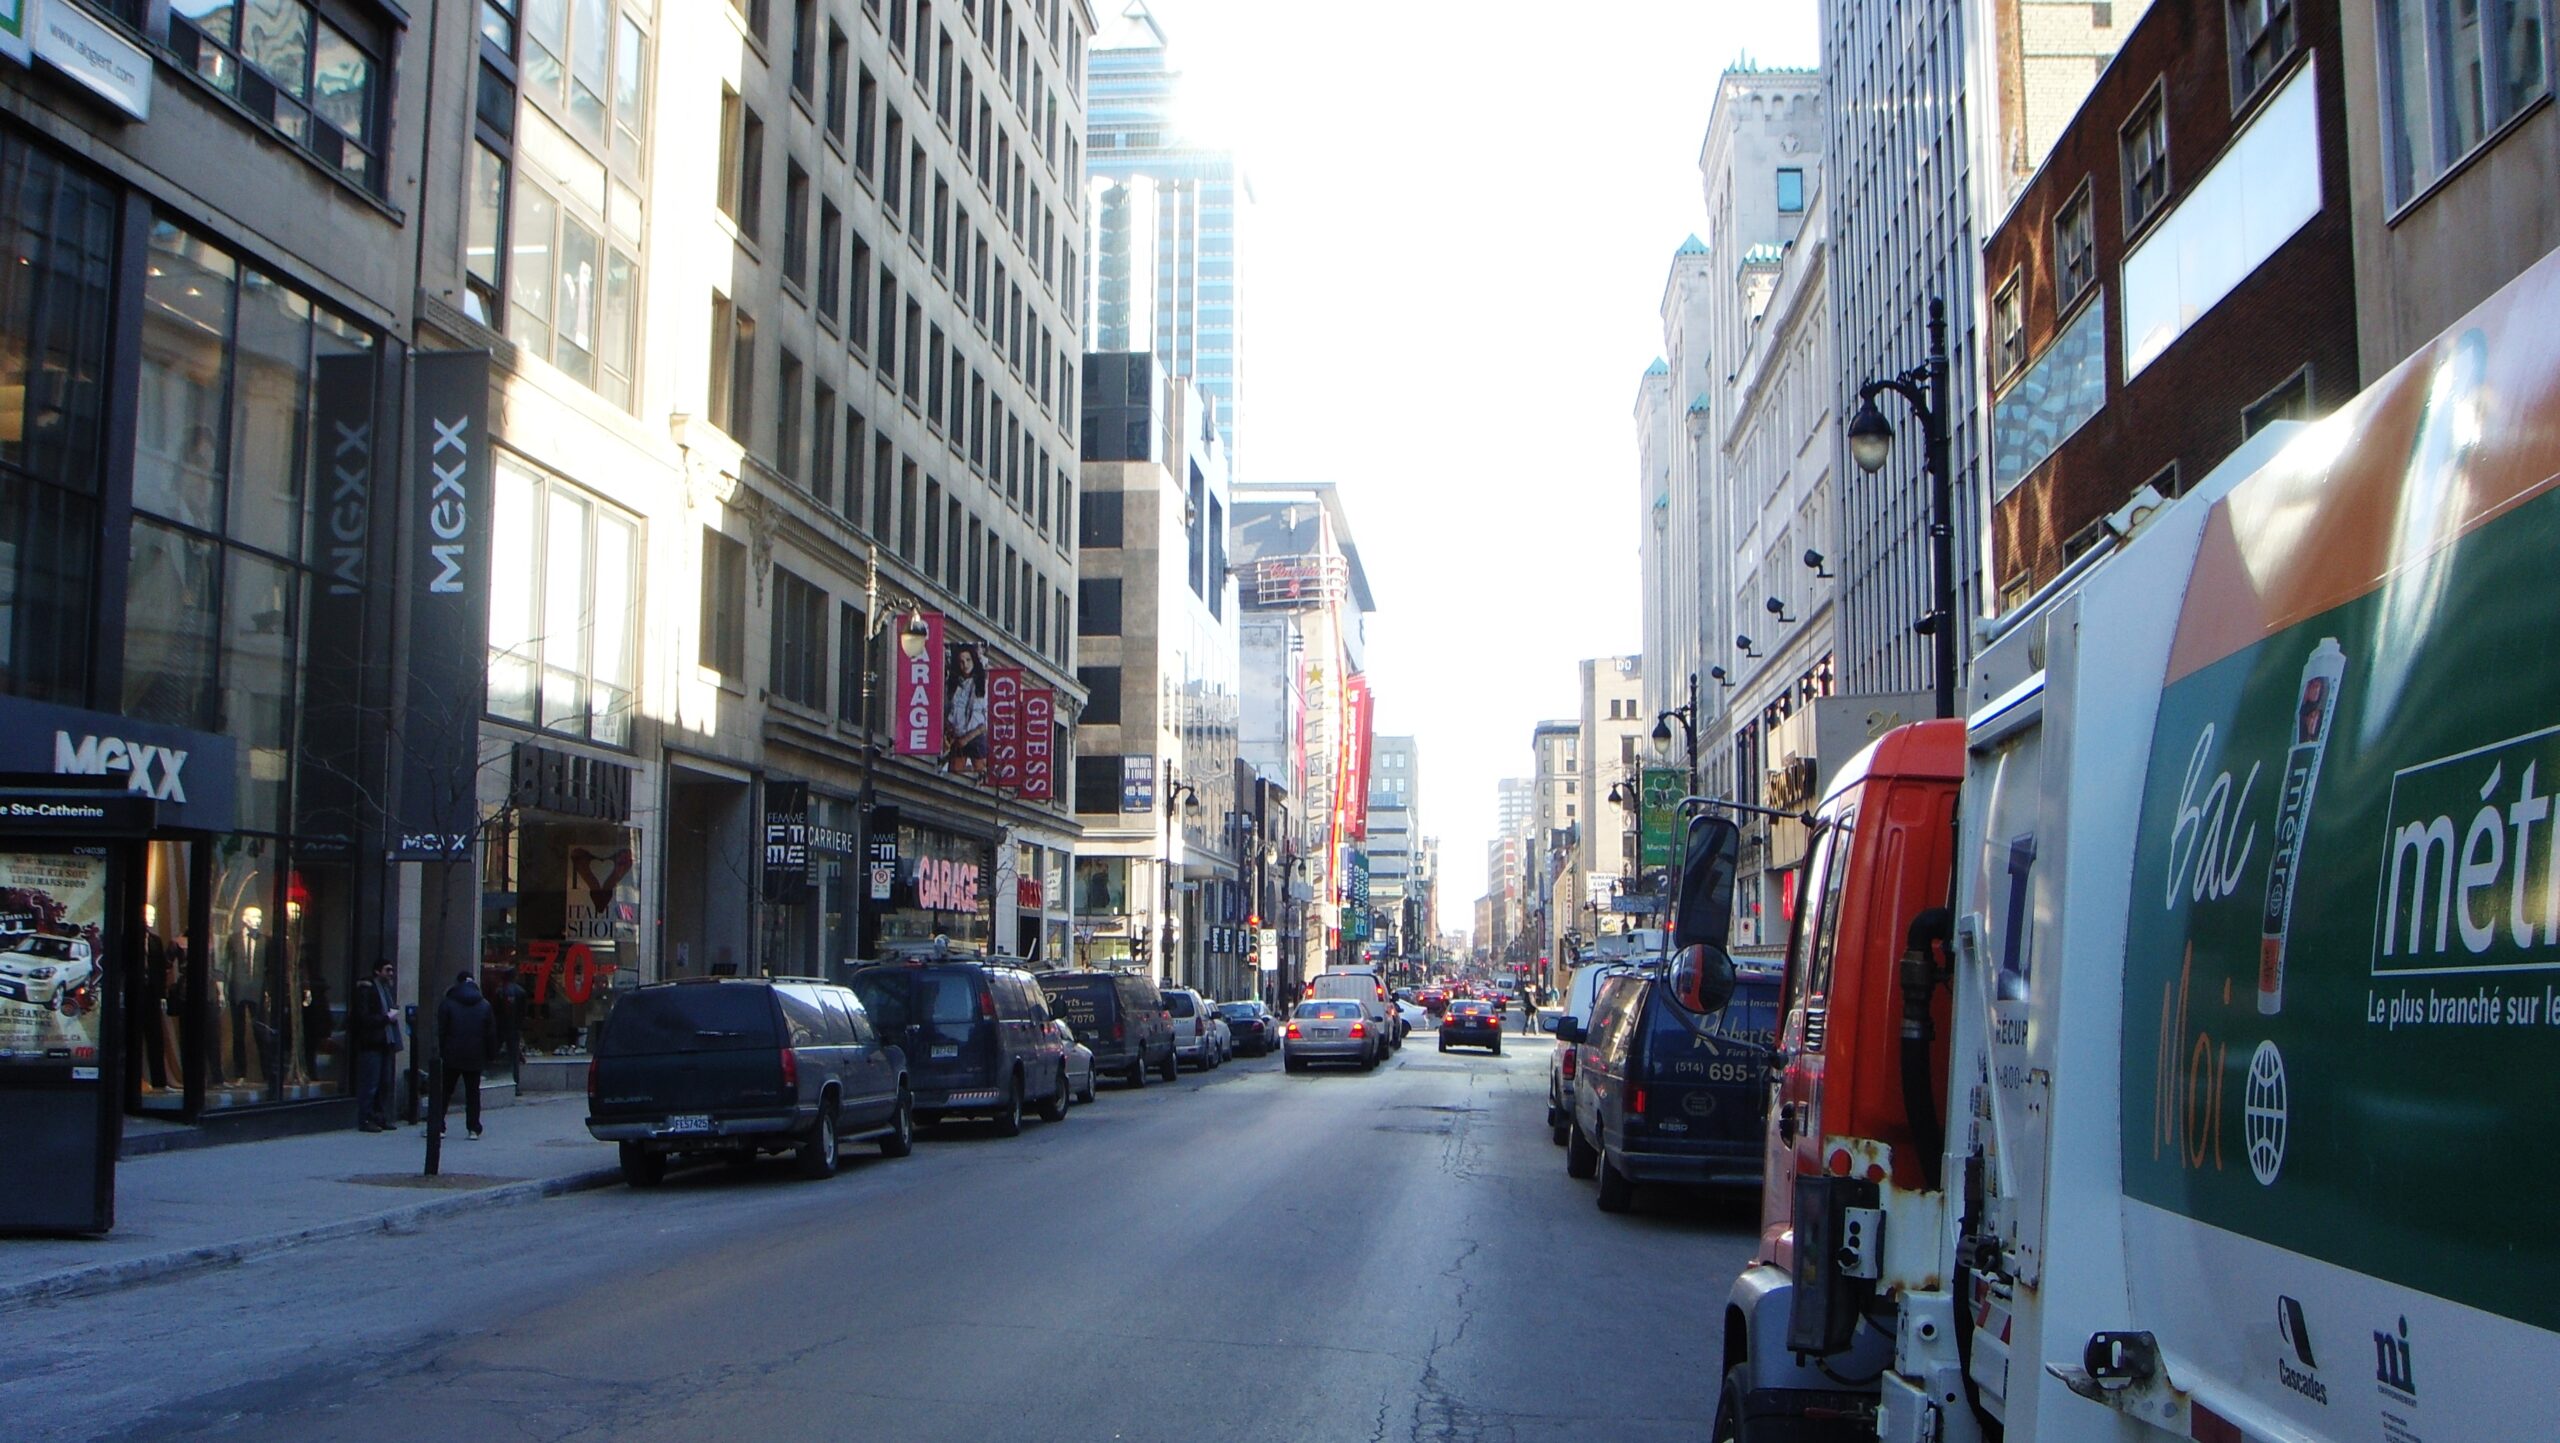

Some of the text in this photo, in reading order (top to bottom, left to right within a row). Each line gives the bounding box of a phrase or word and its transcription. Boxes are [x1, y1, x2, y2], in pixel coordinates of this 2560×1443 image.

[993, 676, 1016, 779] GUESS
[1025, 697, 1048, 792] GUESS
[515, 742, 633, 821] BELLINI
[11, 803, 104, 817] Ste-Catherine
[808, 826, 853, 854] CARRIERE
[918, 855, 979, 914] GARAGE
[528, 938, 593, 1005] 70
[2367, 989, 2386, 1024] Le
[2389, 988, 2424, 1032] plus
[2428, 985, 2500, 1025] branché
[2506, 996, 2539, 1025] sur
[1675, 1062, 1704, 1073] (514)
[2278, 1357, 2328, 1406] Cascades
